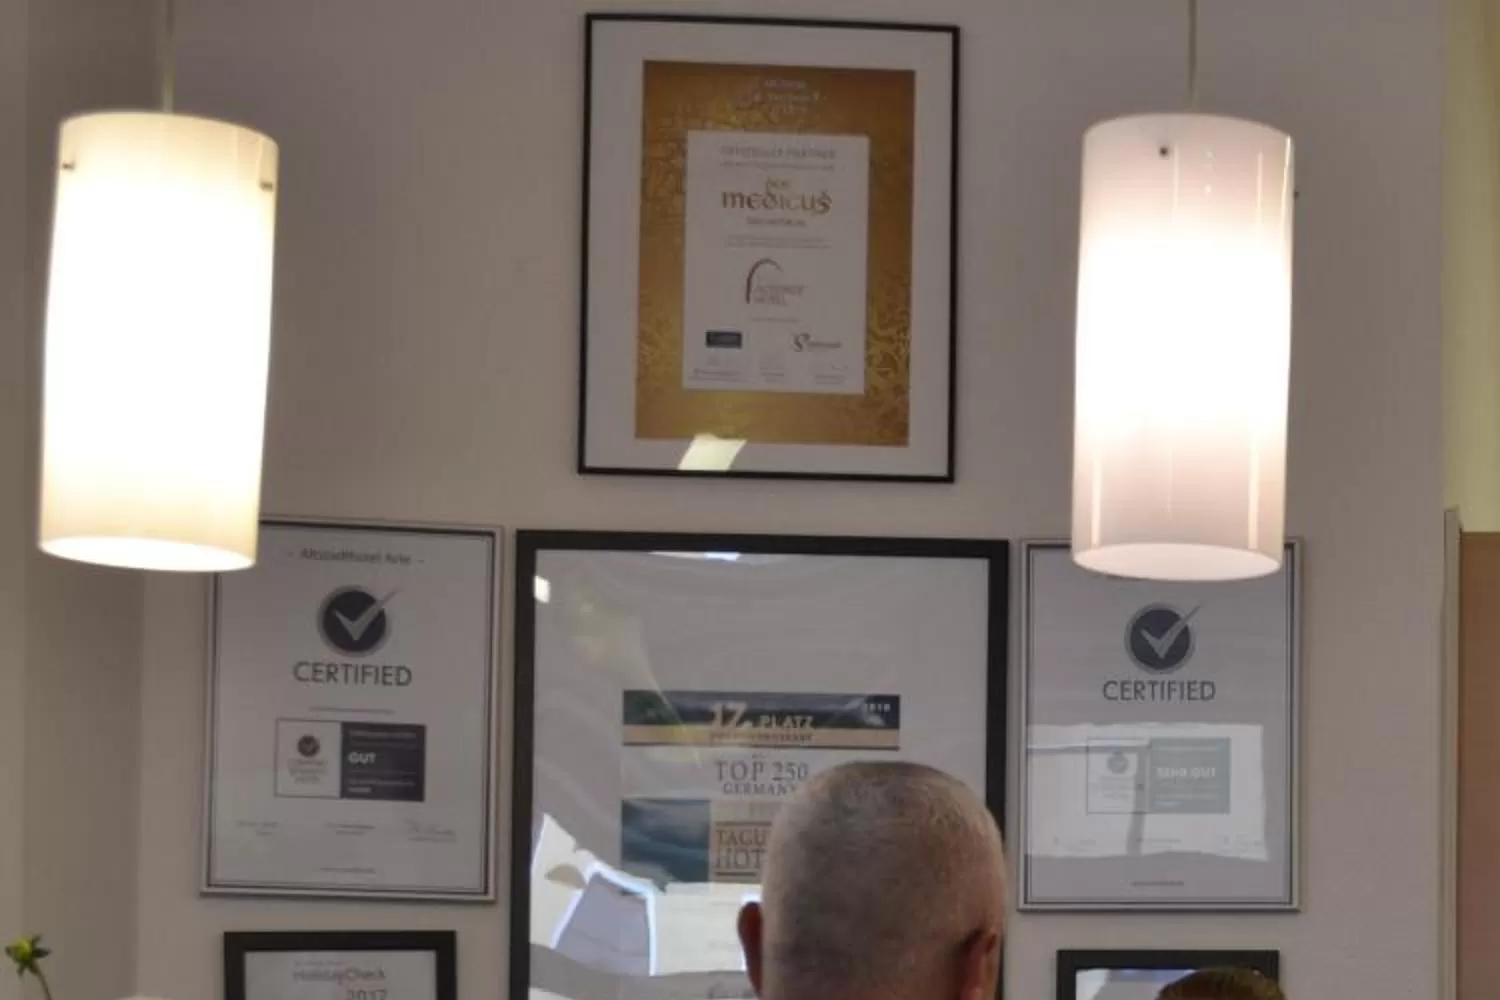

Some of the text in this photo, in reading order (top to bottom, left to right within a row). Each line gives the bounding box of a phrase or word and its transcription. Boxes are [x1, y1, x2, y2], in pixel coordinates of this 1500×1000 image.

[293, 661, 412, 687] CERTIFIED
[1102, 679, 1216, 702] CERTIFIED
[759, 714, 814, 730] PLATZ
[348, 750, 376, 765] GUT
[715, 758, 809, 782] TOP 250
[715, 828, 771, 846] TAGU
[716, 848, 767, 869] HOT
